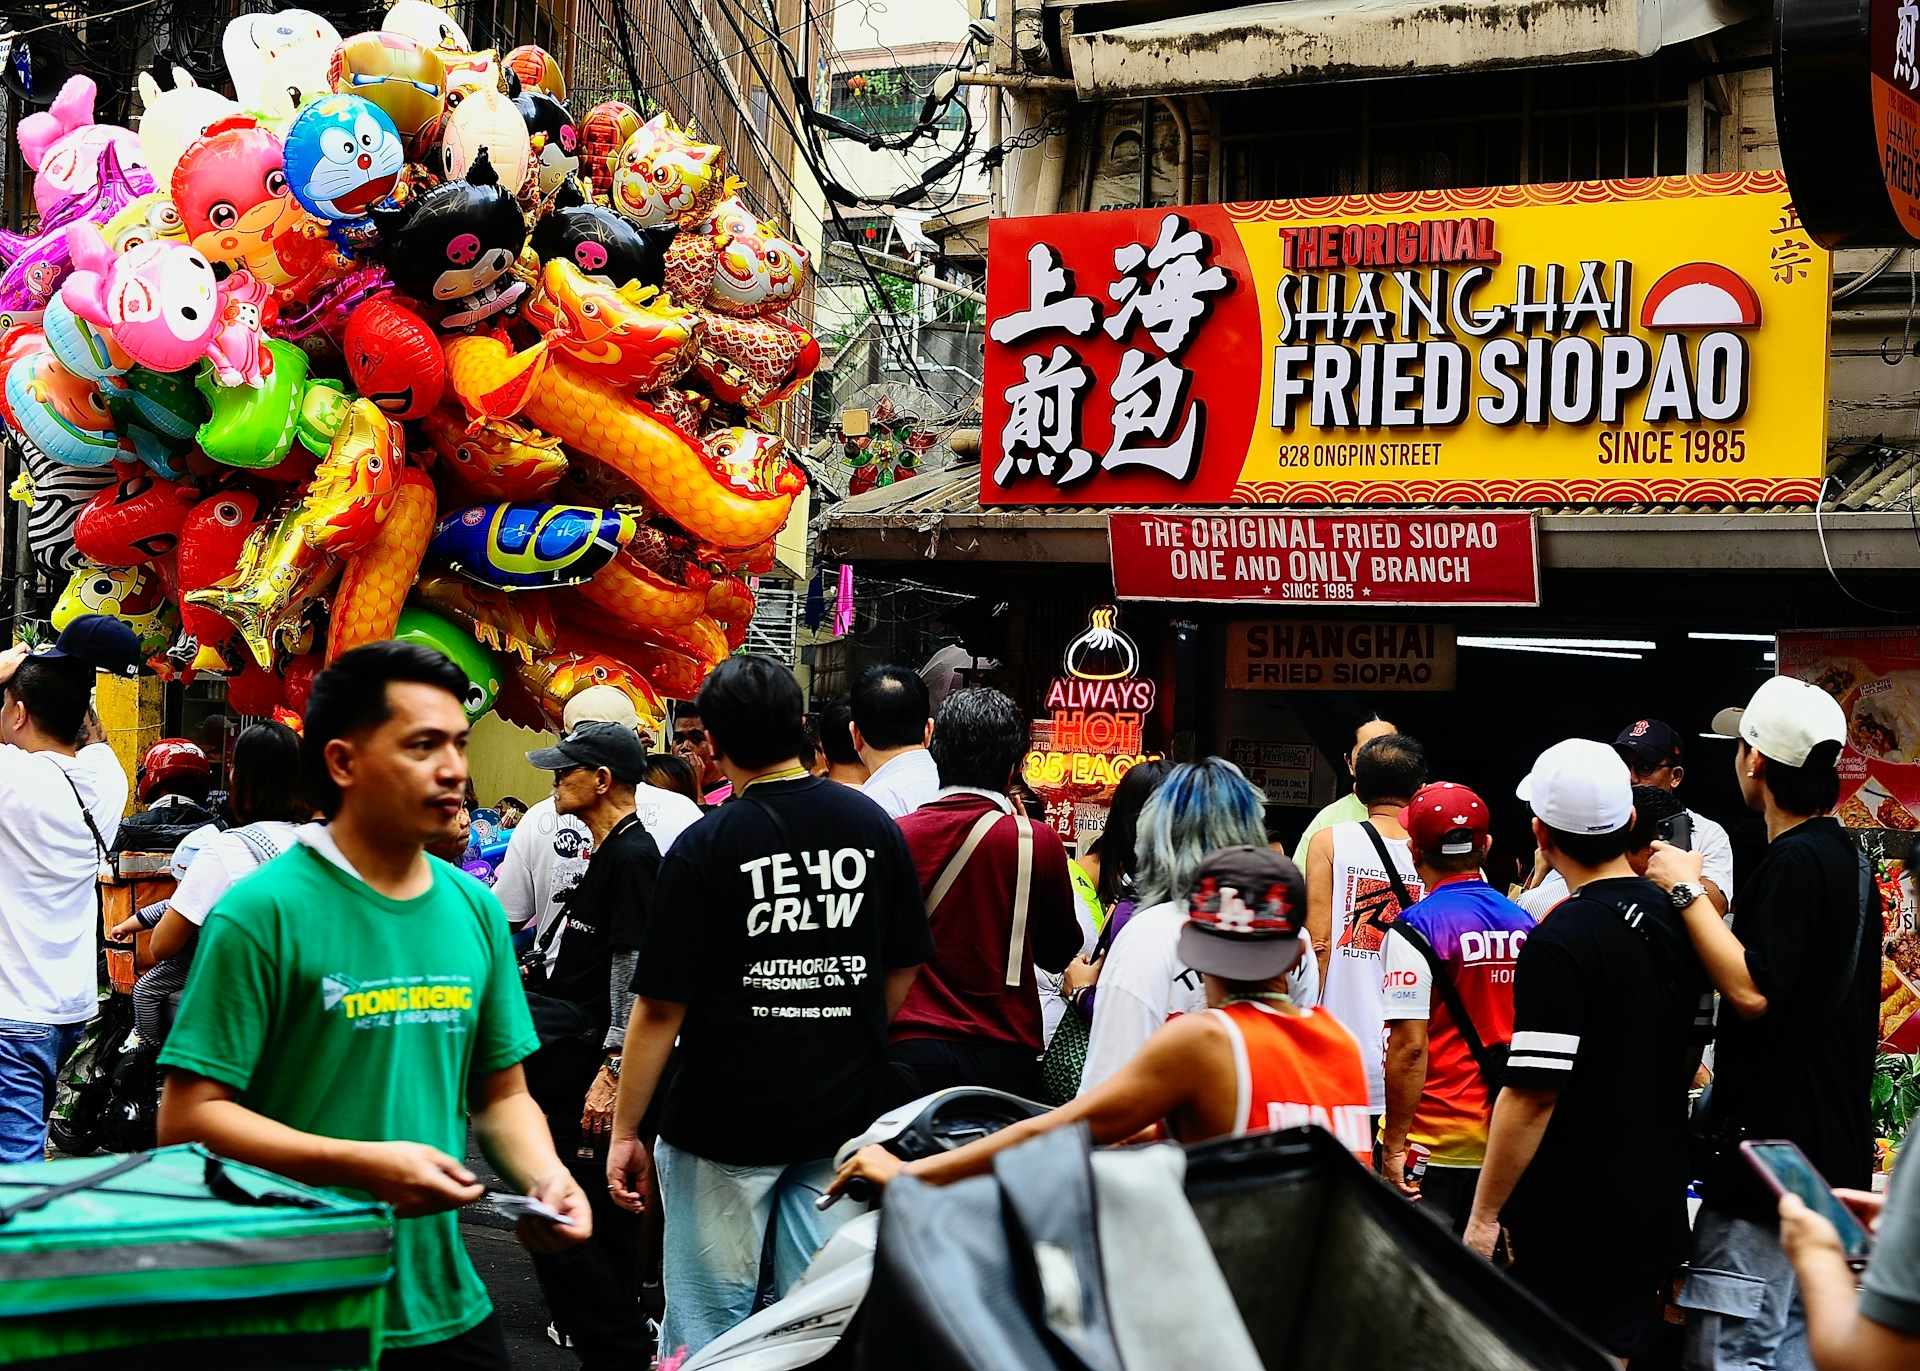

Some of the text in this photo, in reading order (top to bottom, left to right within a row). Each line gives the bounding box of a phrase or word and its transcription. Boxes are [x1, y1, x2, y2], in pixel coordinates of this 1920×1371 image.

[1280, 218, 1500, 270] THE ORIGINAL
[1769, 202, 1812, 284] 正宗
[990, 214, 1228, 352] 上海
[1276, 261, 1627, 343] SHANGHAI
[1272, 332, 1746, 428] FRIED SIOPAO
[992, 345, 1197, 486] 煎包
[1279, 442, 1442, 467] 828 ONGPIN STREET
[1598, 428, 1747, 465] SINCE 1985
[1141, 517, 1498, 550] THE ORIGINAL FRIED SIOPAO
[1170, 549, 1471, 584] ONE AND ONLY BRANCH
[1282, 582, 1354, 599] SINCE 1985
[1246, 625, 1435, 660] SHANGHAI
[1247, 662, 1432, 685] FRIED SIOPAO
[1047, 681, 1150, 710] ALWAYS
[1054, 711, 1140, 751] HOT
[1025, 751, 1161, 785] 35 EAC
[1290, 778, 1307, 788] ONLY
[1074, 818, 1098, 831] FRIED
[1347, 866, 1423, 883] SINCE 985
[1491, 969, 1515, 984] HO
[342, 986, 408, 1018] TIONG
[752, 1006, 769, 1018] TO
[802, 1006, 821, 1018] HIS
[822, 1006, 852, 1018] OWN
